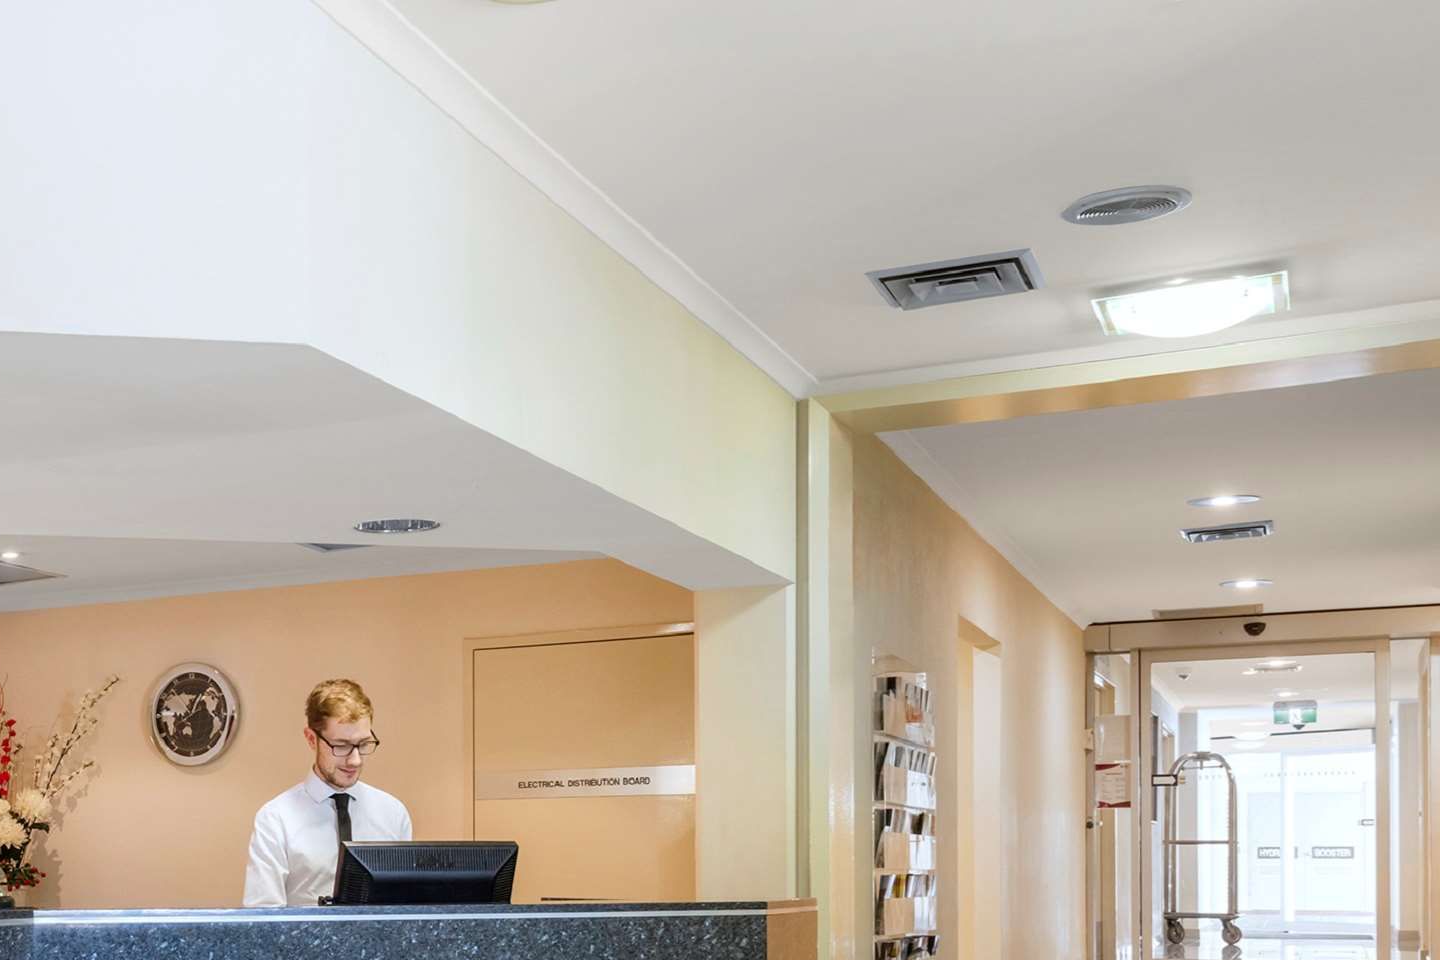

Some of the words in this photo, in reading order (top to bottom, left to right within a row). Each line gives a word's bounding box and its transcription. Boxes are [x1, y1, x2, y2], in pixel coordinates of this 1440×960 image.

[518, 780, 564, 789] ELECTRICAL
[567, 778, 620, 787] DISTRIBUTION
[622, 776, 651, 786] BOARD
